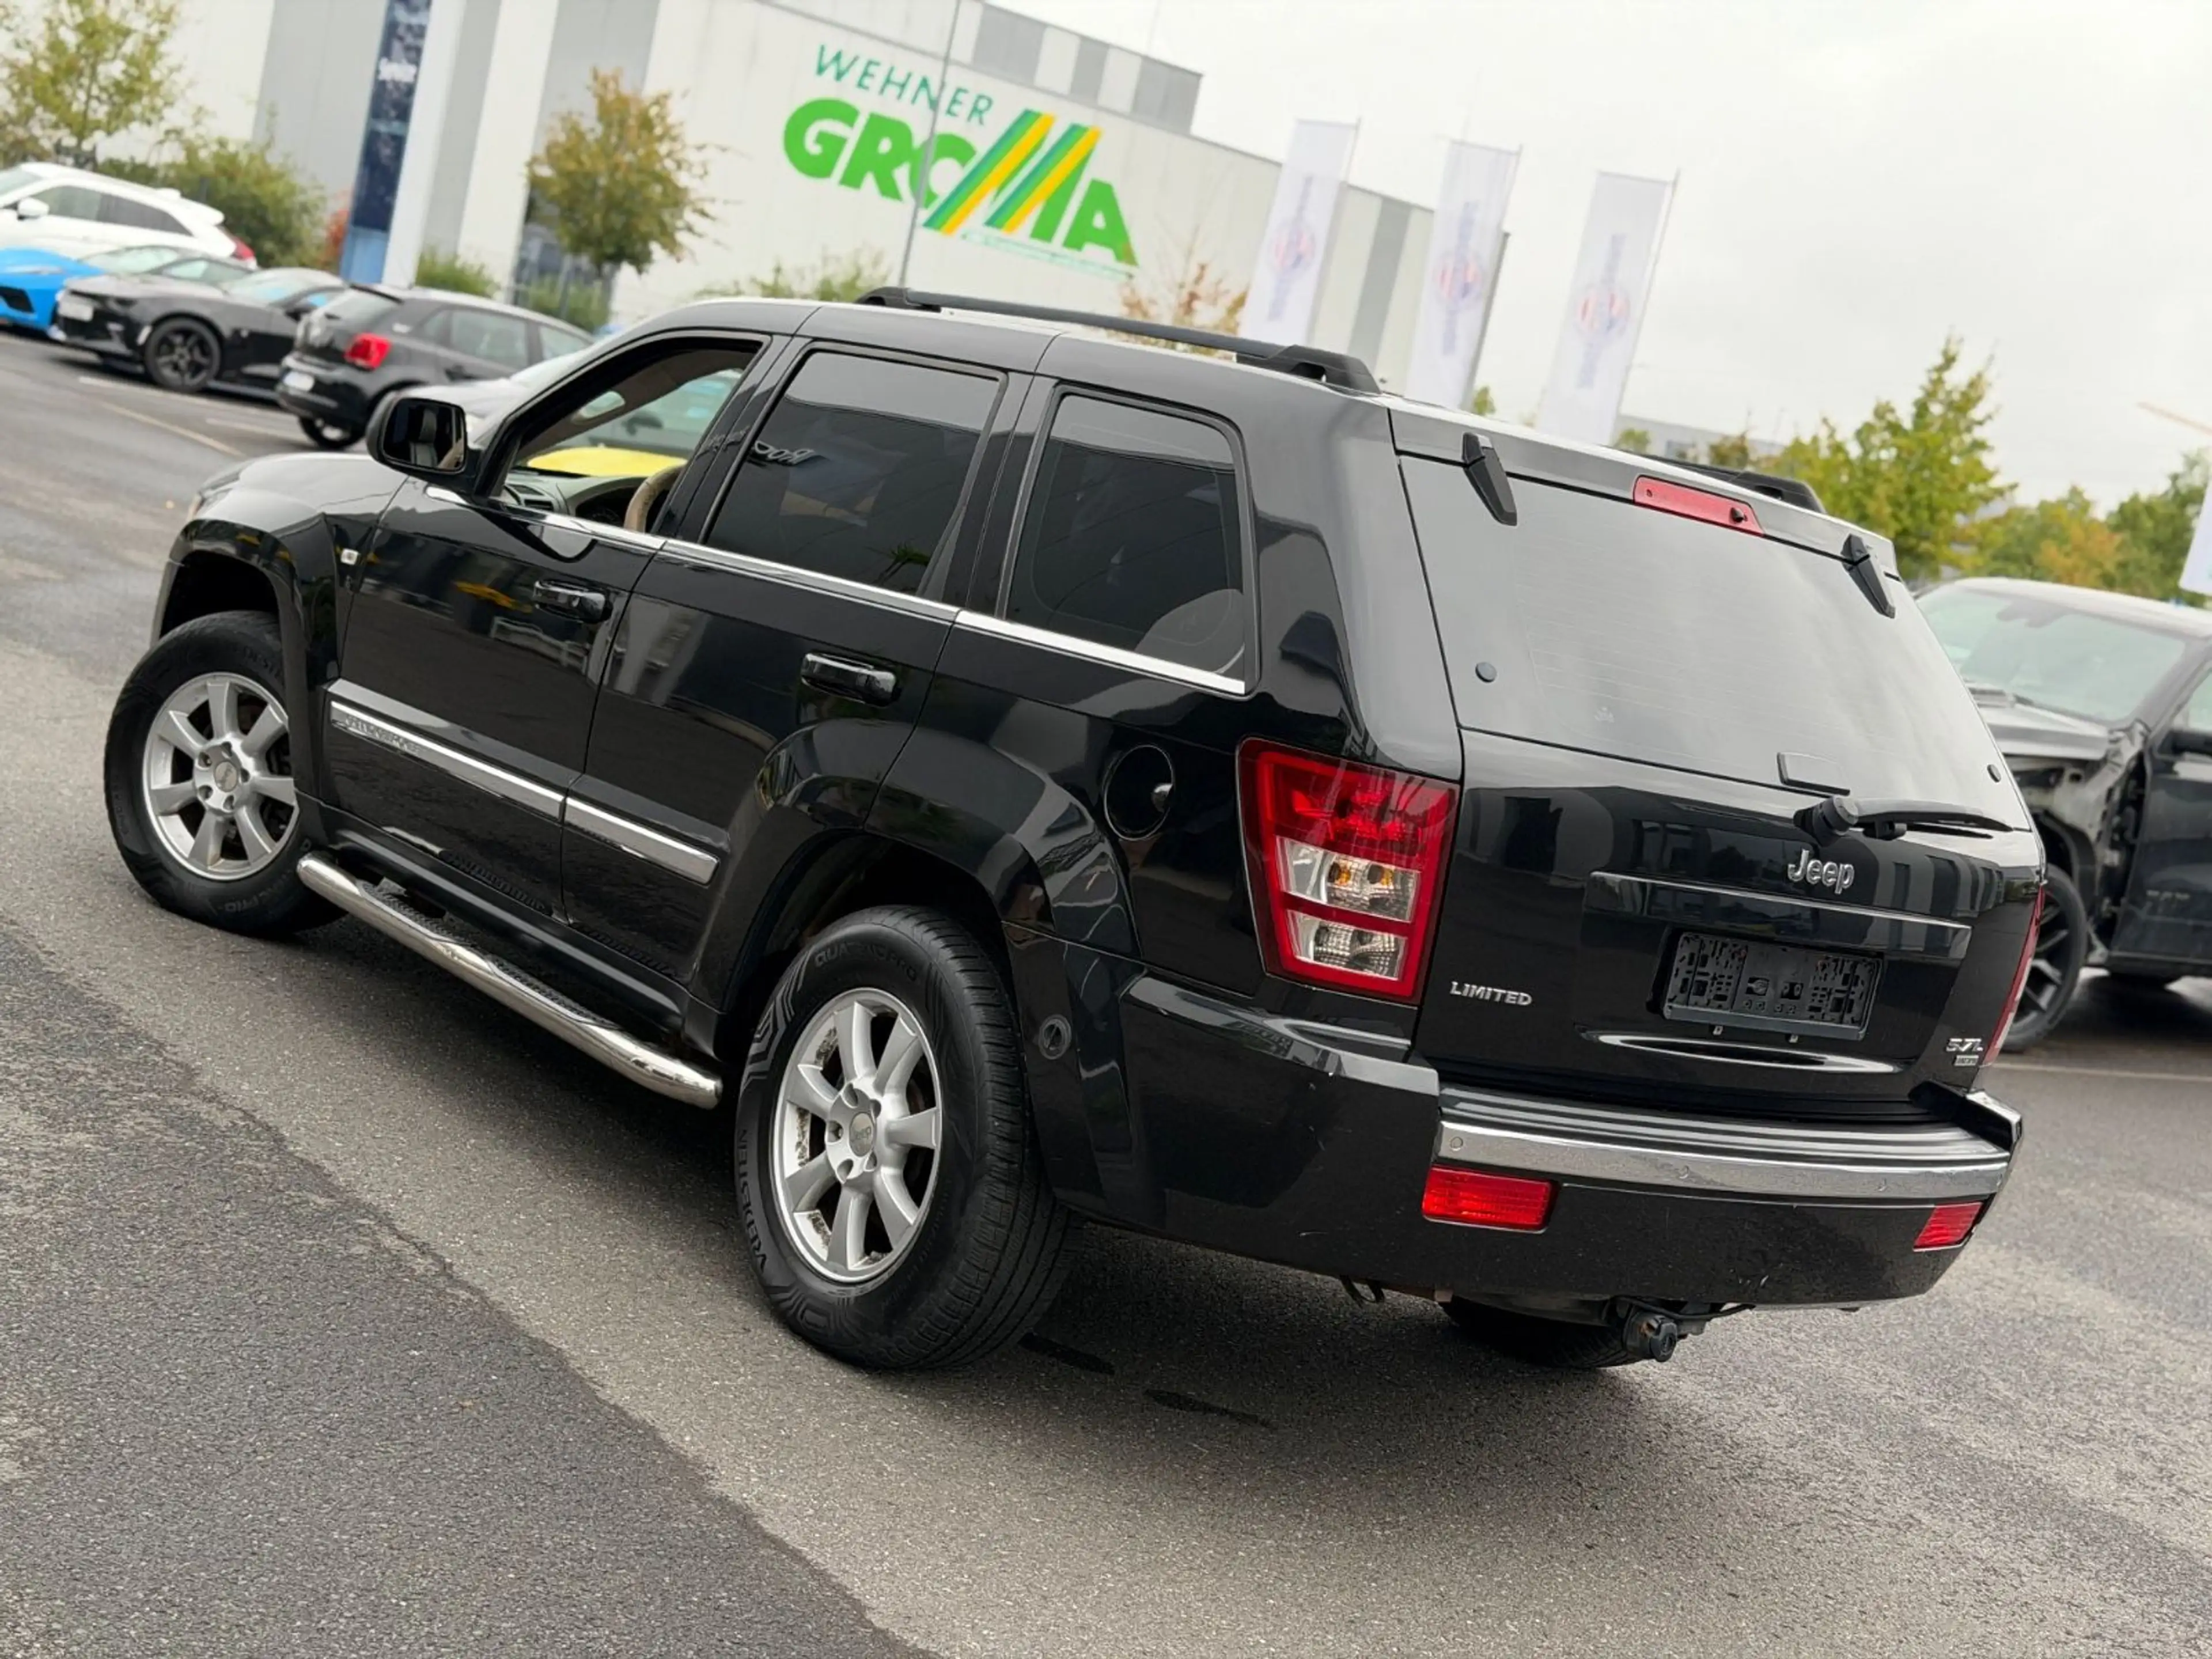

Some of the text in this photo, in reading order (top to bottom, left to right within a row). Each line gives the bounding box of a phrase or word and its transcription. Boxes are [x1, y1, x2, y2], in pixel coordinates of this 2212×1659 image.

[816, 44, 994, 126] WEHNER
[783, 97, 1139, 267] GROMA
[1787, 849, 1855, 895] Jeep
[1449, 981, 1533, 1006] LIMITED
